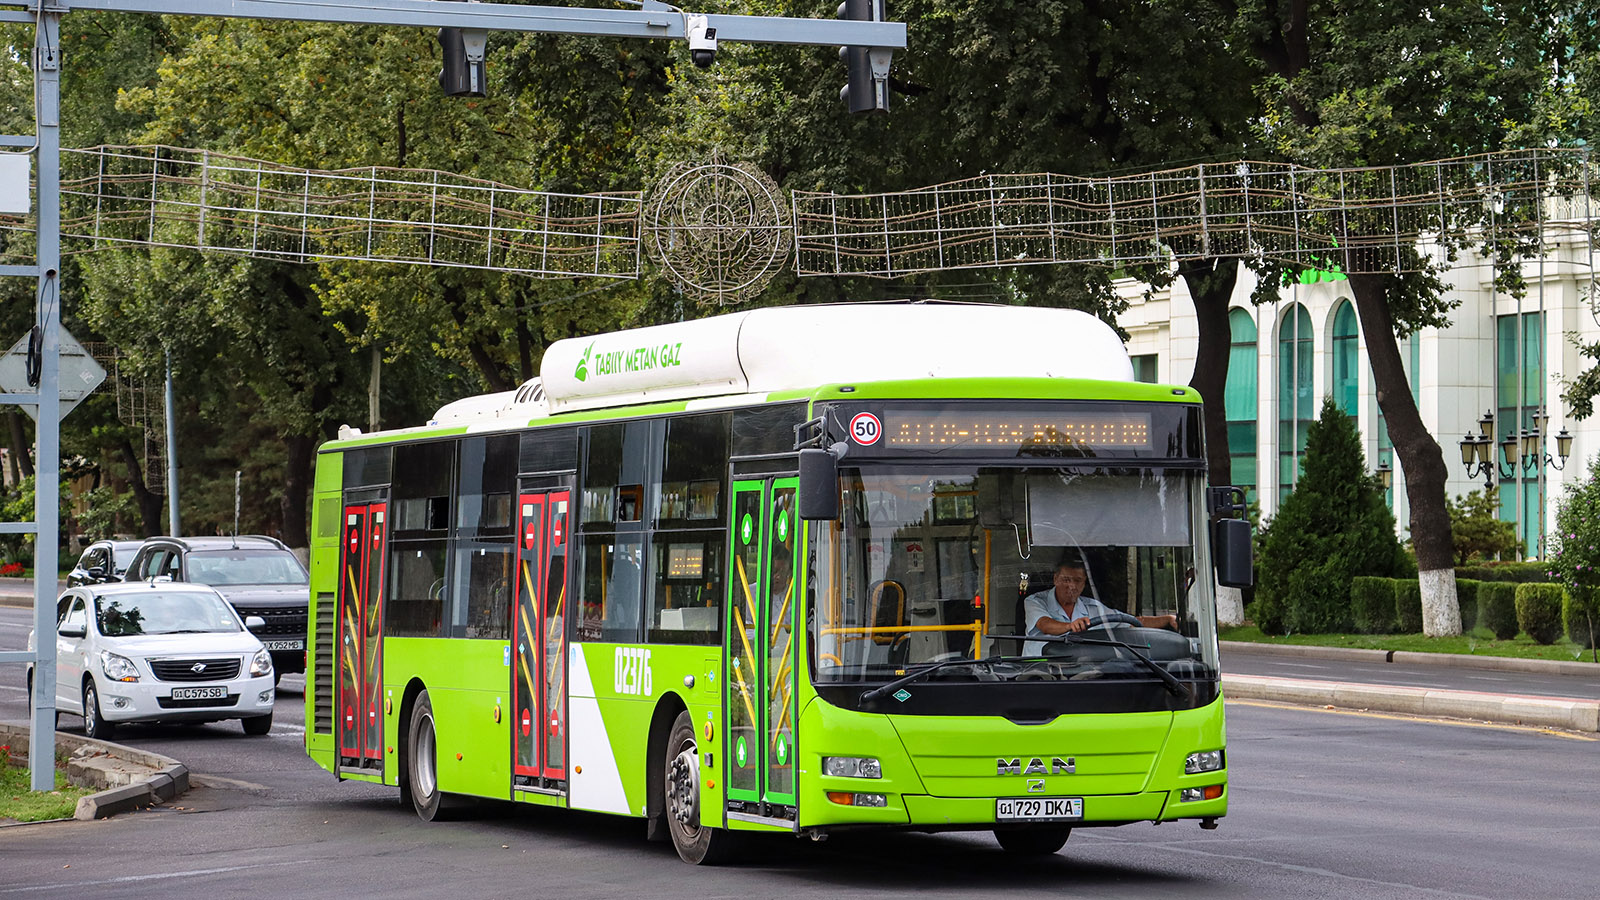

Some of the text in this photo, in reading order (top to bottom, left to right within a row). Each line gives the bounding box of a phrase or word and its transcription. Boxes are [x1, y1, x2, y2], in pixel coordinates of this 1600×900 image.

[595, 343, 682, 376] TABIIY METAN GAZ
[855, 421, 876, 436] 50
[614, 646, 652, 697] 02376
[997, 757, 1076, 775] MAN
[1015, 801, 1041, 816] 729
[1045, 800, 1073, 816] DKA
